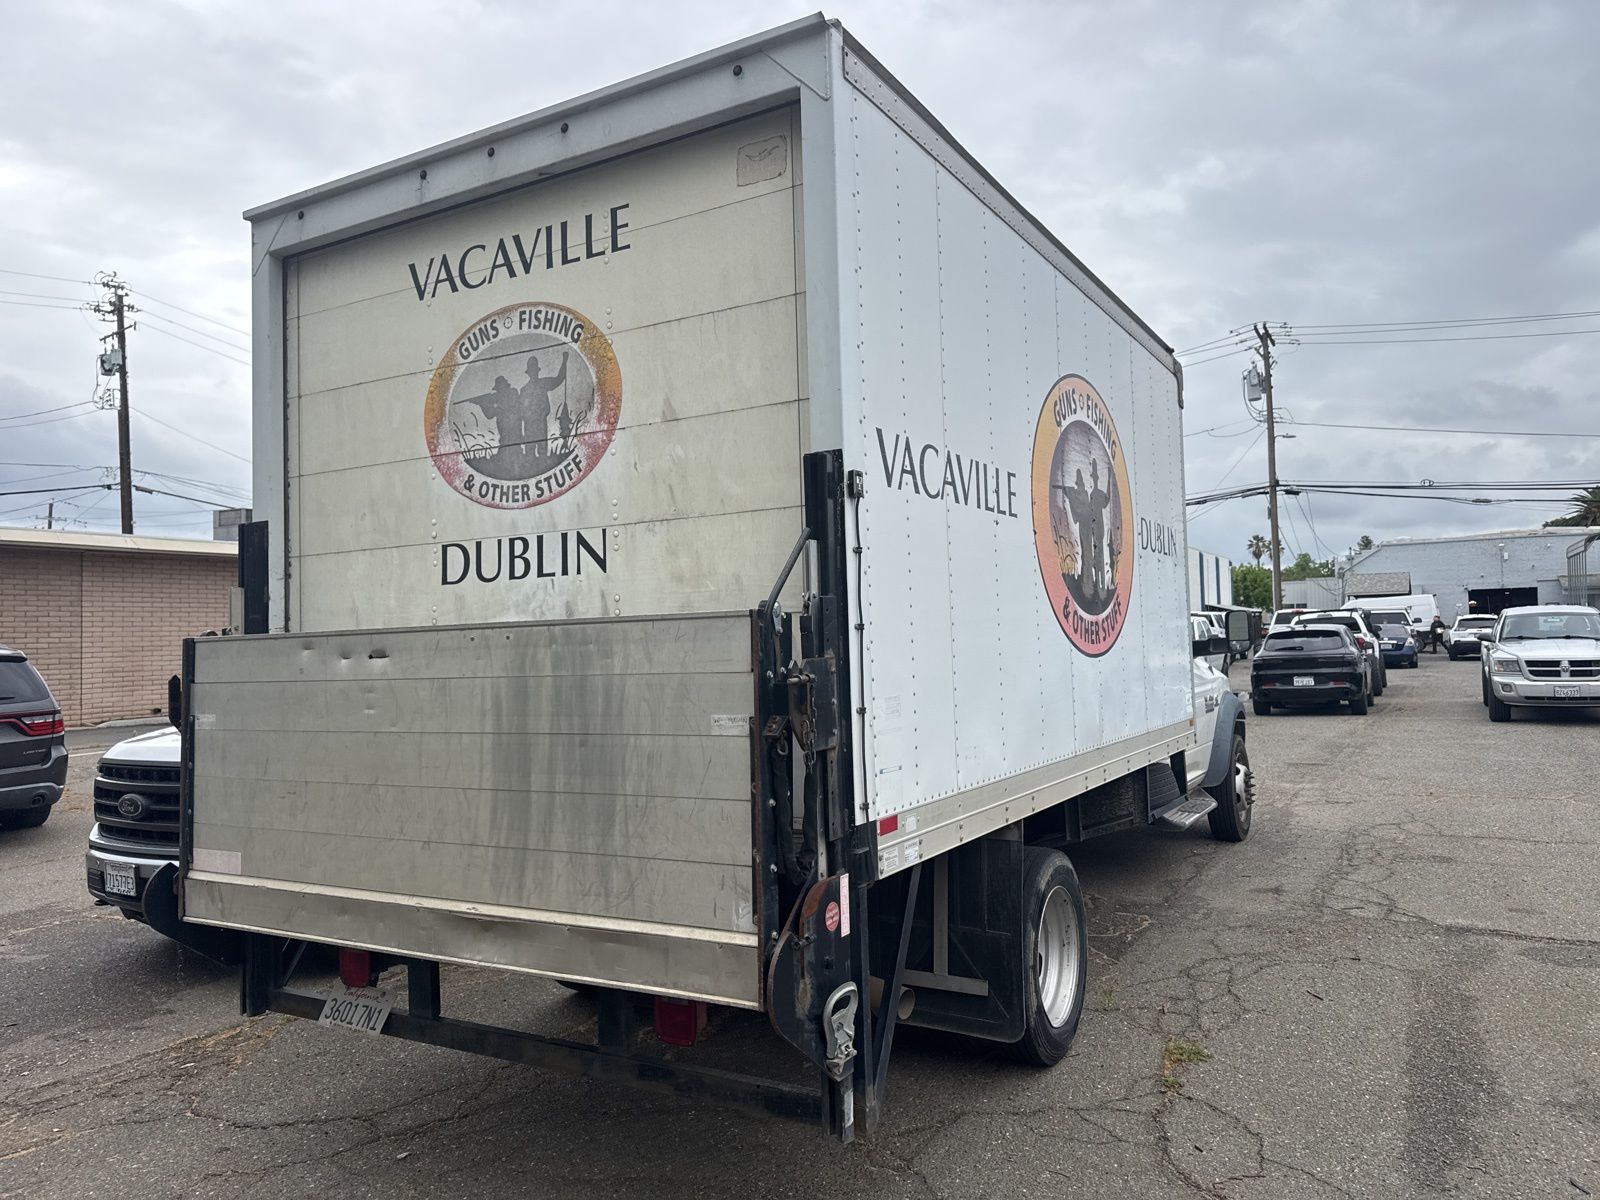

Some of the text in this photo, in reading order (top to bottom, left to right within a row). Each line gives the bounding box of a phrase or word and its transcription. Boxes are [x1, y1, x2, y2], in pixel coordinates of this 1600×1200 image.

[408, 203, 631, 301] VACAVILLE
[459, 309, 584, 360] GUNS FISHING
[1054, 388, 1117, 462] GUNS FISHING
[463, 454, 583, 503] & OTHER STUFF
[876, 427, 1018, 519] VACAVILLE
[441, 528, 608, 586] DUBLIN
[1140, 517, 1177, 558] DUBLIN
[1063, 593, 1122, 645] & OTHER STUFF
[325, 998, 382, 1031] 36017N1
